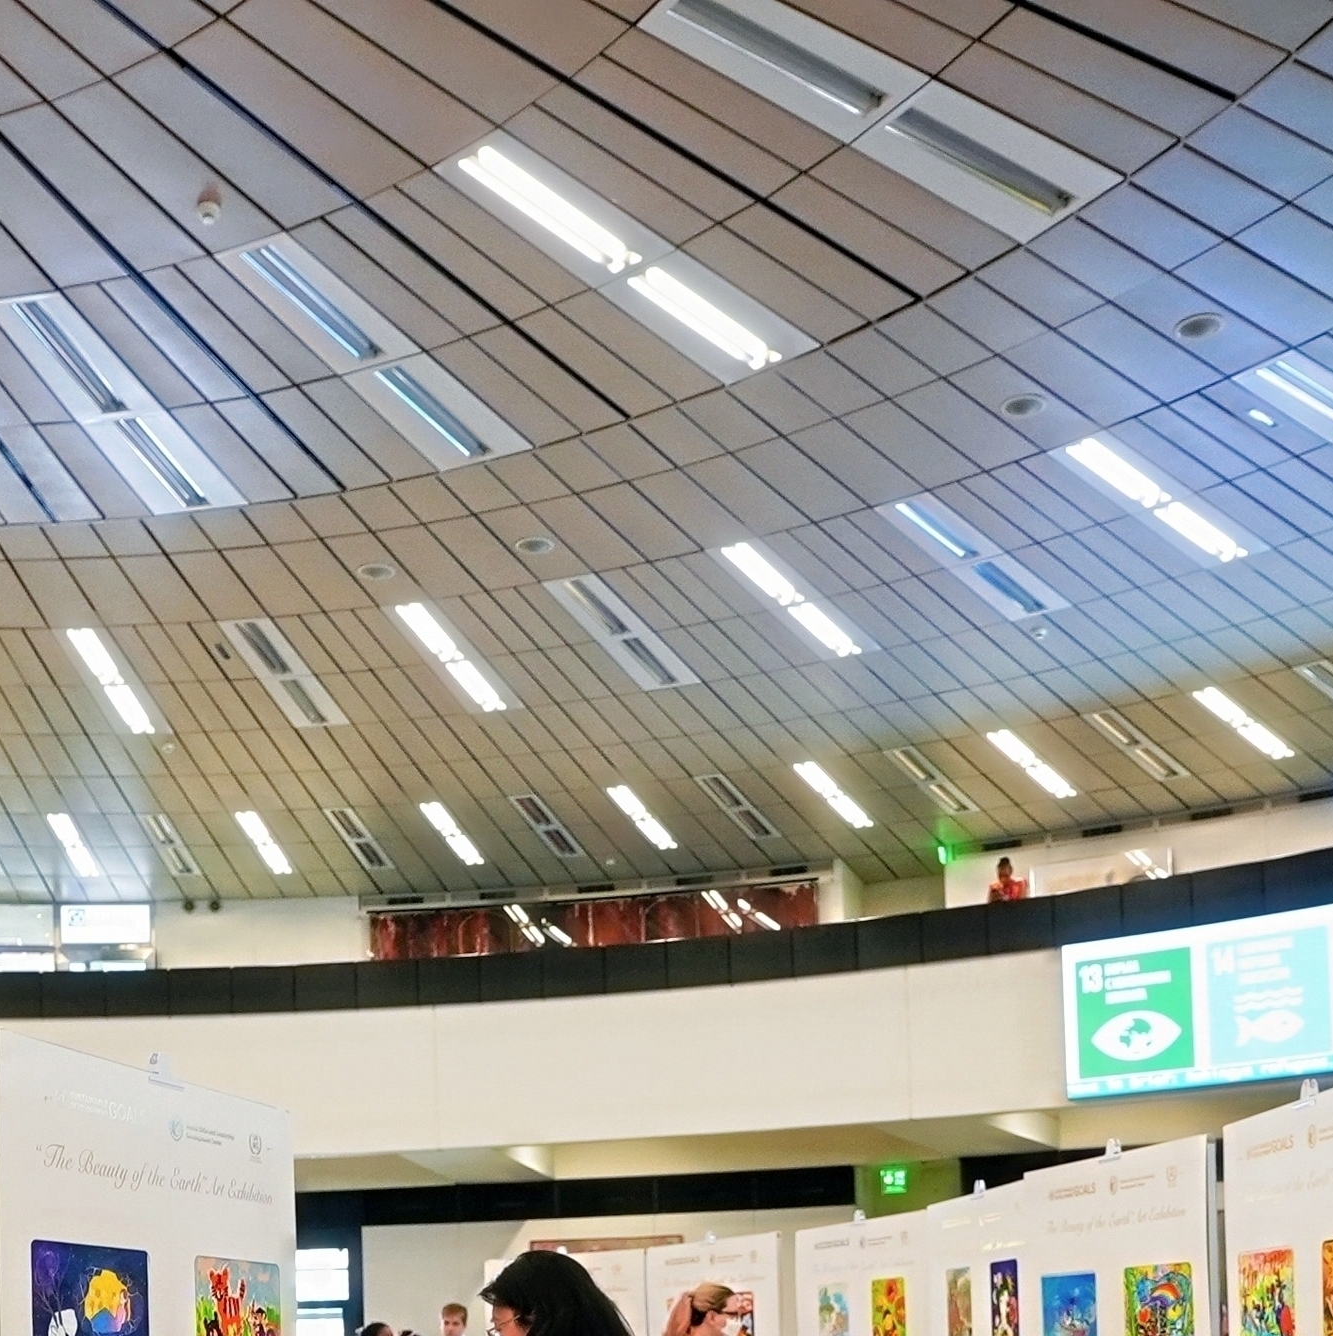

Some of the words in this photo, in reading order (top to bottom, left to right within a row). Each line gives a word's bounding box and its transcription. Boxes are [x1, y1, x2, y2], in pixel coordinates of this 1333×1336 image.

[1078, 963, 1104, 994] 13
[78, 1149, 128, 1189] Beauty
[131, 1163, 150, 1191] of
[147, 1164, 165, 1188] the
[205, 1177, 225, 1196] Art
[227, 1179, 274, 1206] Exhibition
